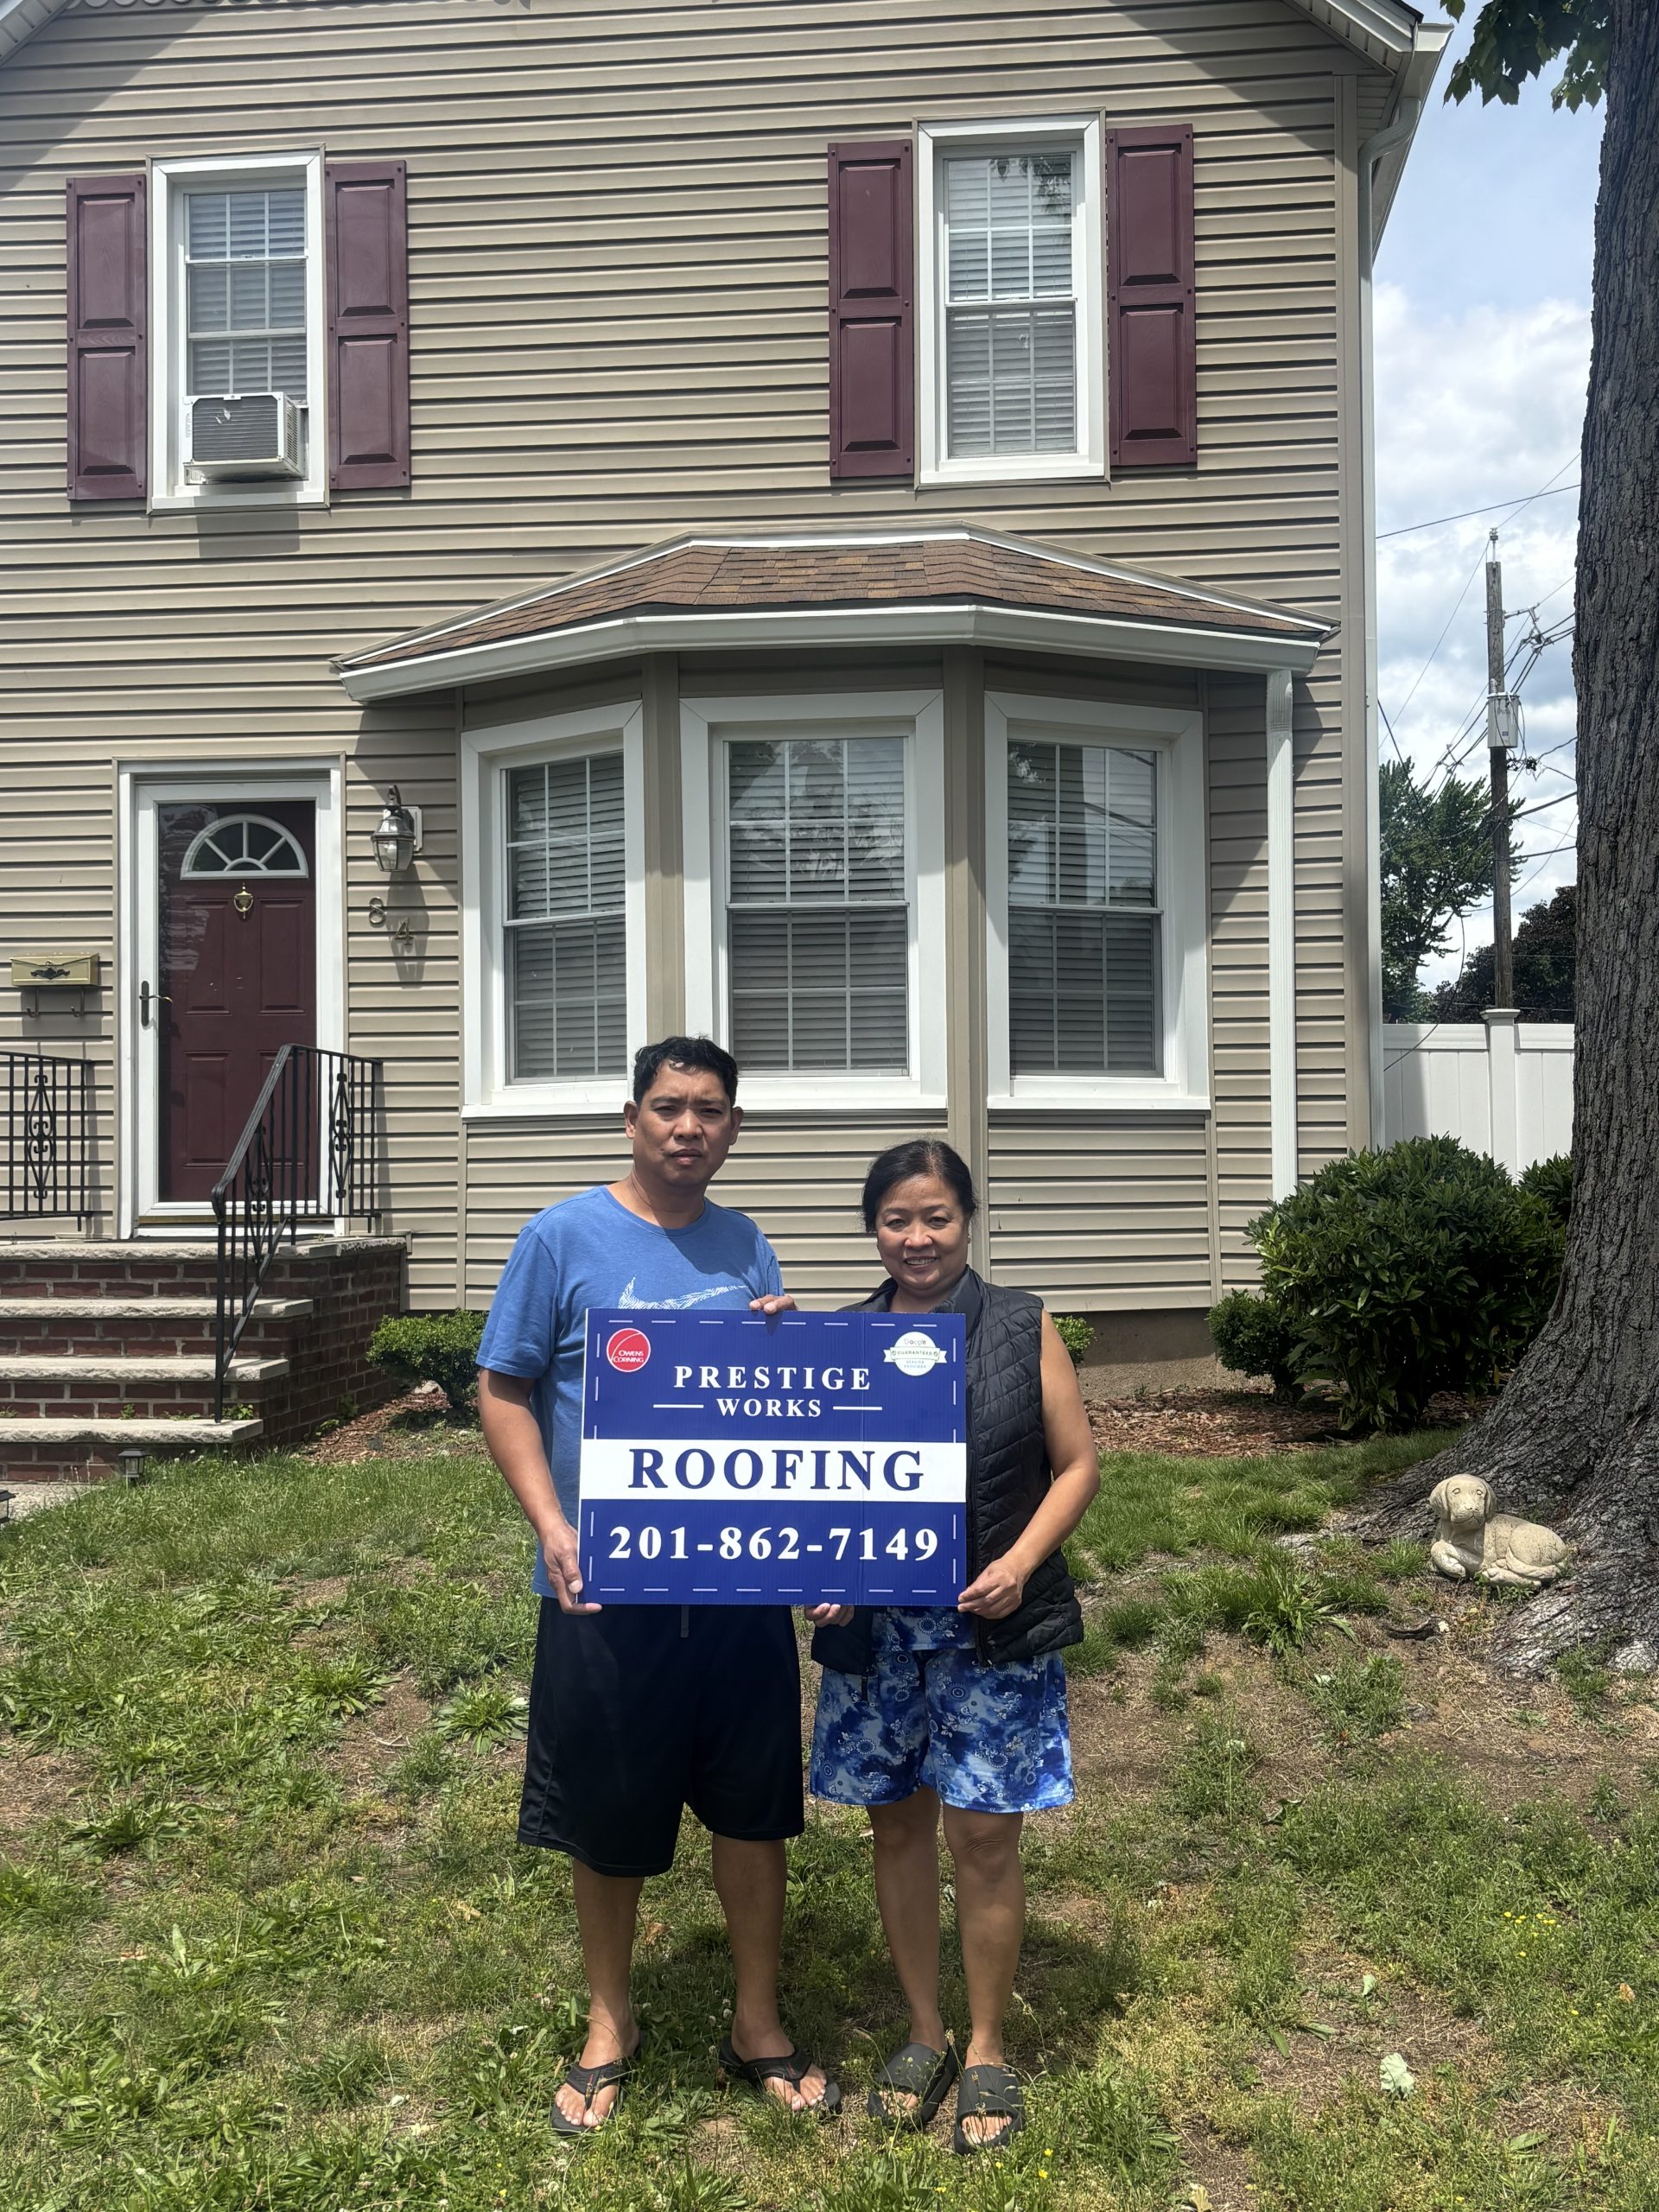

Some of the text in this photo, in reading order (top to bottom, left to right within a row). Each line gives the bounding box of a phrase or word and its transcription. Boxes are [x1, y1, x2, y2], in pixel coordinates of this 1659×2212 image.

[673, 1365, 870, 1390] PRESTIGE
[715, 1398, 821, 1418] WORKS
[627, 1448, 925, 1491] ROOFING
[608, 1526, 938, 1561] 201-862-7149
